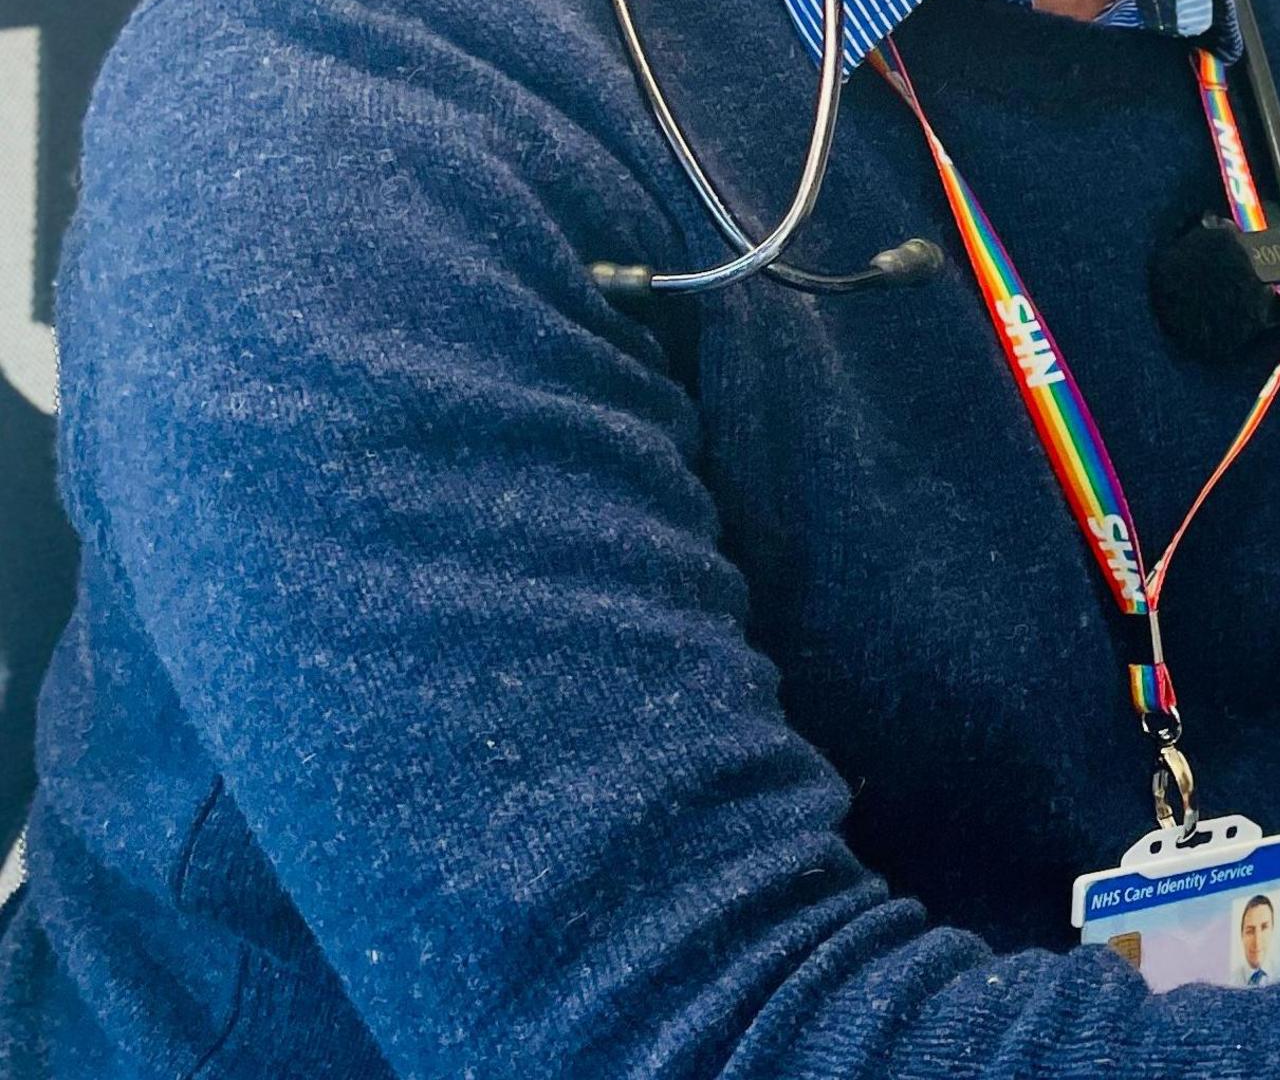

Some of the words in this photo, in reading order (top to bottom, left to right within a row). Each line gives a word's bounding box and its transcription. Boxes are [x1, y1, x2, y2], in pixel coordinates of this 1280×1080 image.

[1213, 118, 1257, 206] NHS
[995, 293, 1067, 389] NHS
[1087, 513, 1148, 604] NHS
[1091, 889, 1121, 910] NHS
[1124, 886, 1154, 903] Care
[1156, 871, 1207, 896] Identity
[1209, 863, 1255, 885] Service
